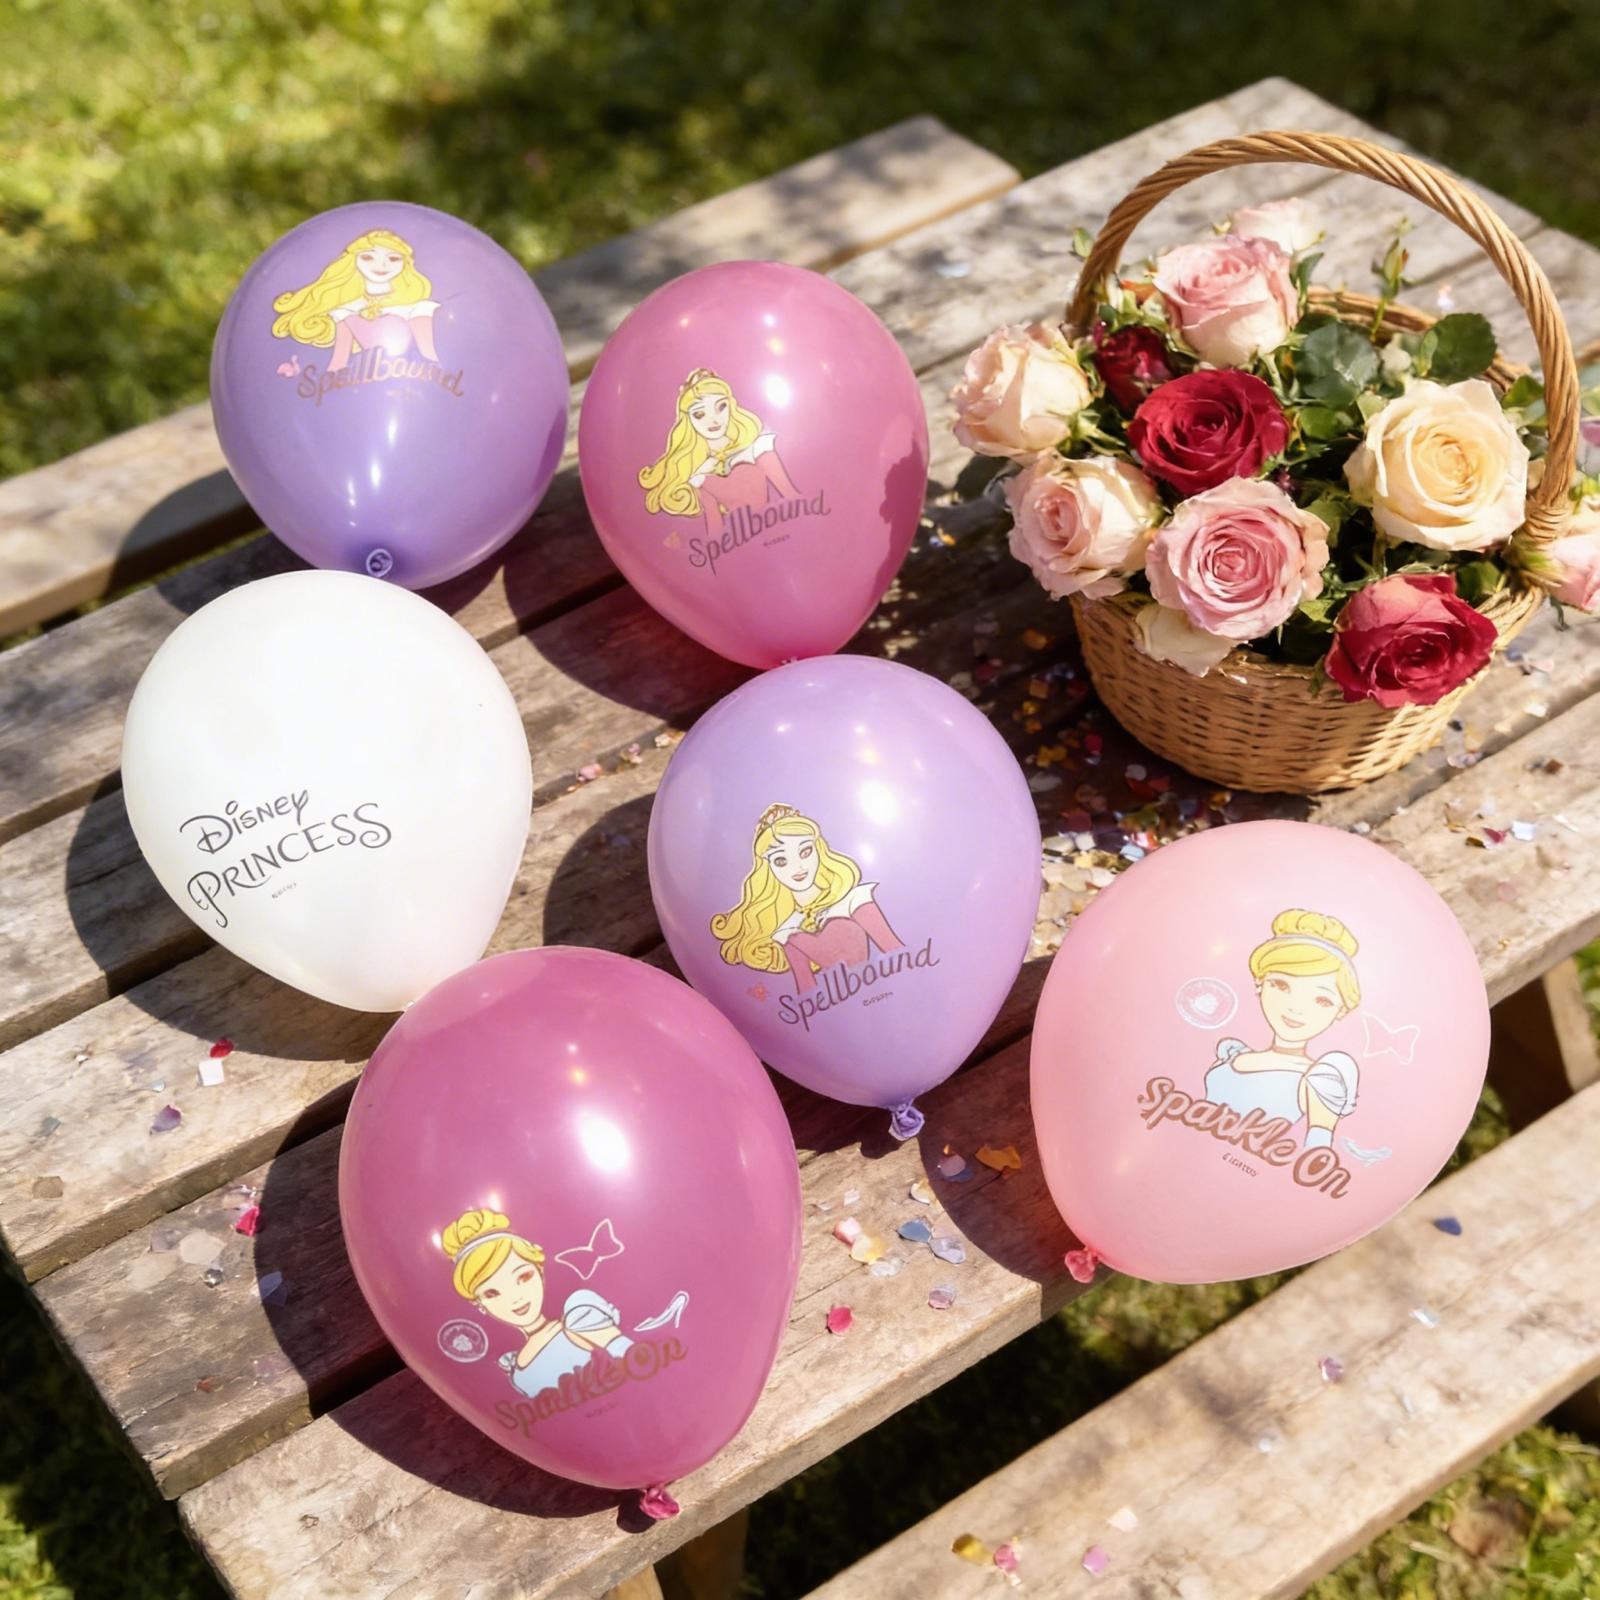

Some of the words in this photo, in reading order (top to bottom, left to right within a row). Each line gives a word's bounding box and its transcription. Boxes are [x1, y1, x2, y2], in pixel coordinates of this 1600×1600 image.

[297, 345, 464, 407] Spellbound
[688, 489, 832, 577] Spellbound
[179, 789, 309, 854] Disney
[187, 802, 392, 928] PRINCESS
[777, 937, 940, 1032] Spellbound
[1136, 1076, 1298, 1167] Sparkle
[1292, 1145, 1351, 1199] On
[493, 1346, 628, 1438] Sparkle
[622, 1336, 689, 1382] On
